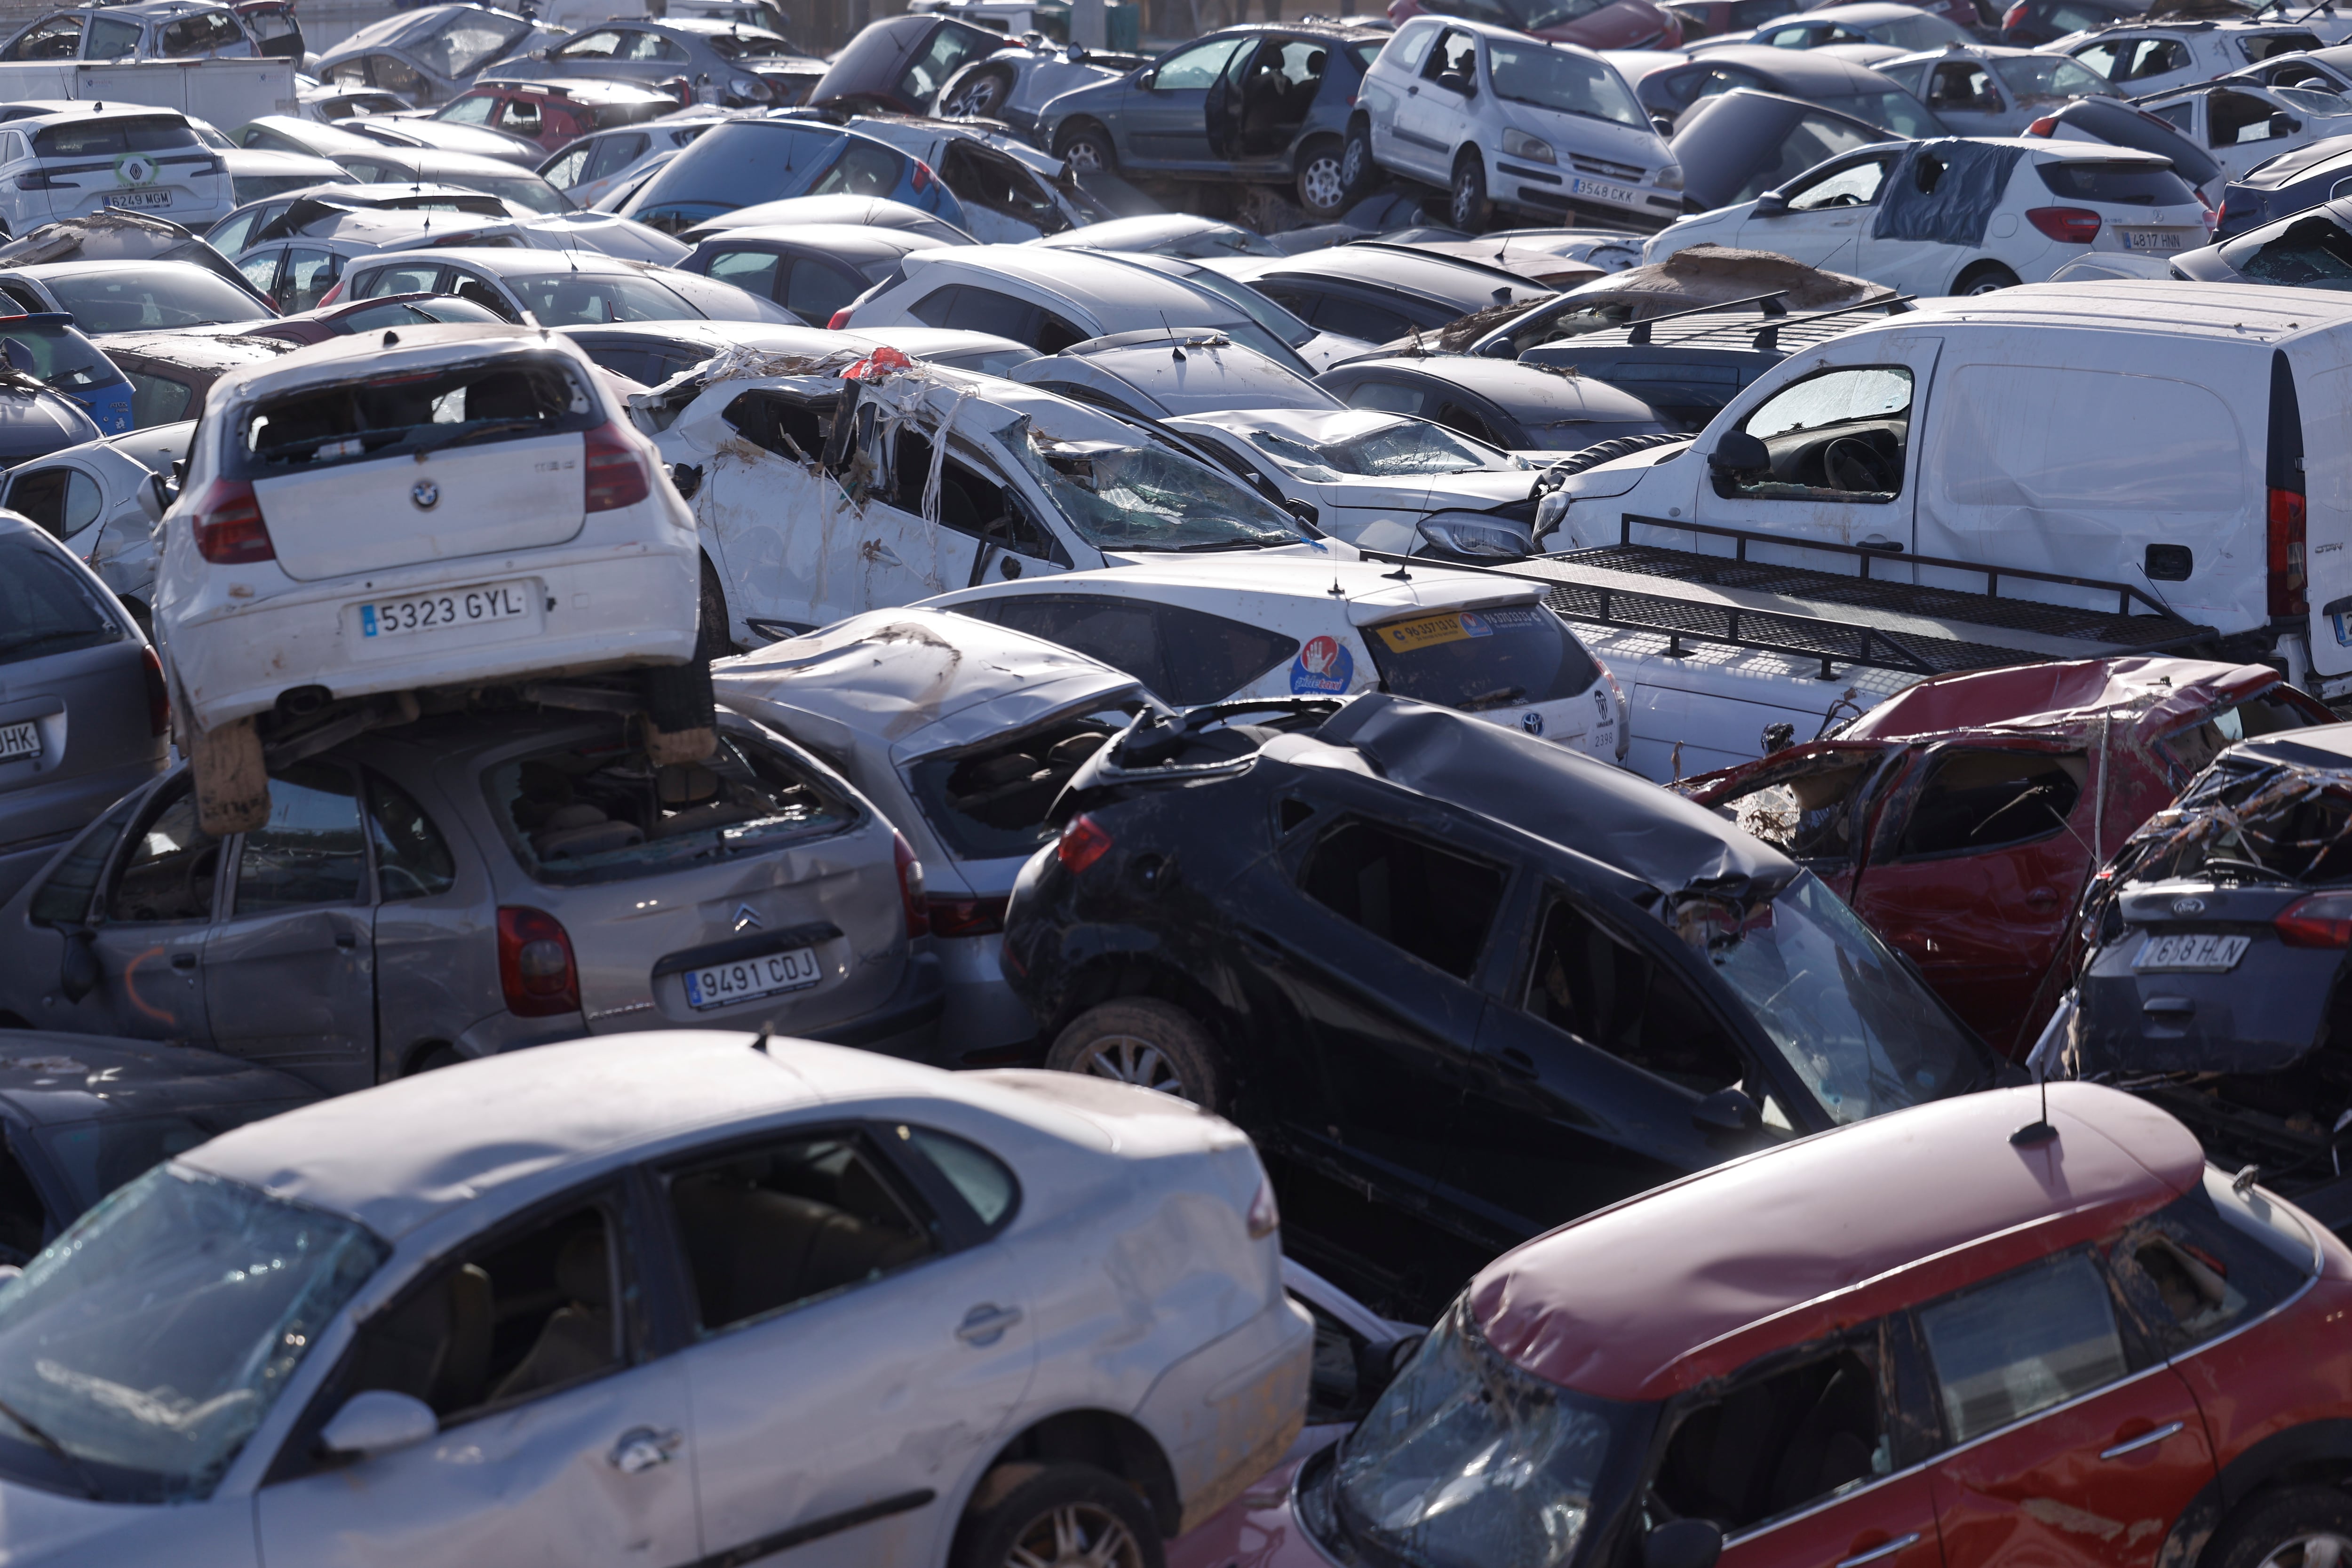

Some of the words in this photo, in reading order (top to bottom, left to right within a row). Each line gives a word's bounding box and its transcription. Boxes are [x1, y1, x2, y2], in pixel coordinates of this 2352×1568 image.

[112, 195, 142, 207] 6249
[145, 192, 168, 204] MGM
[1579, 182, 1608, 197] 3548
[1611, 189, 1633, 202] CKK
[2133, 234, 2158, 247] 4817
[2161, 234, 2180, 247] HNN
[381, 597, 456, 632] 5323
[465, 589, 521, 619] GYL
[1295, 676, 1343, 691] pidetaxi
[1595, 732, 1613, 748] 2398
[702, 962, 762, 997] 9491
[767, 952, 813, 983] CDJ
